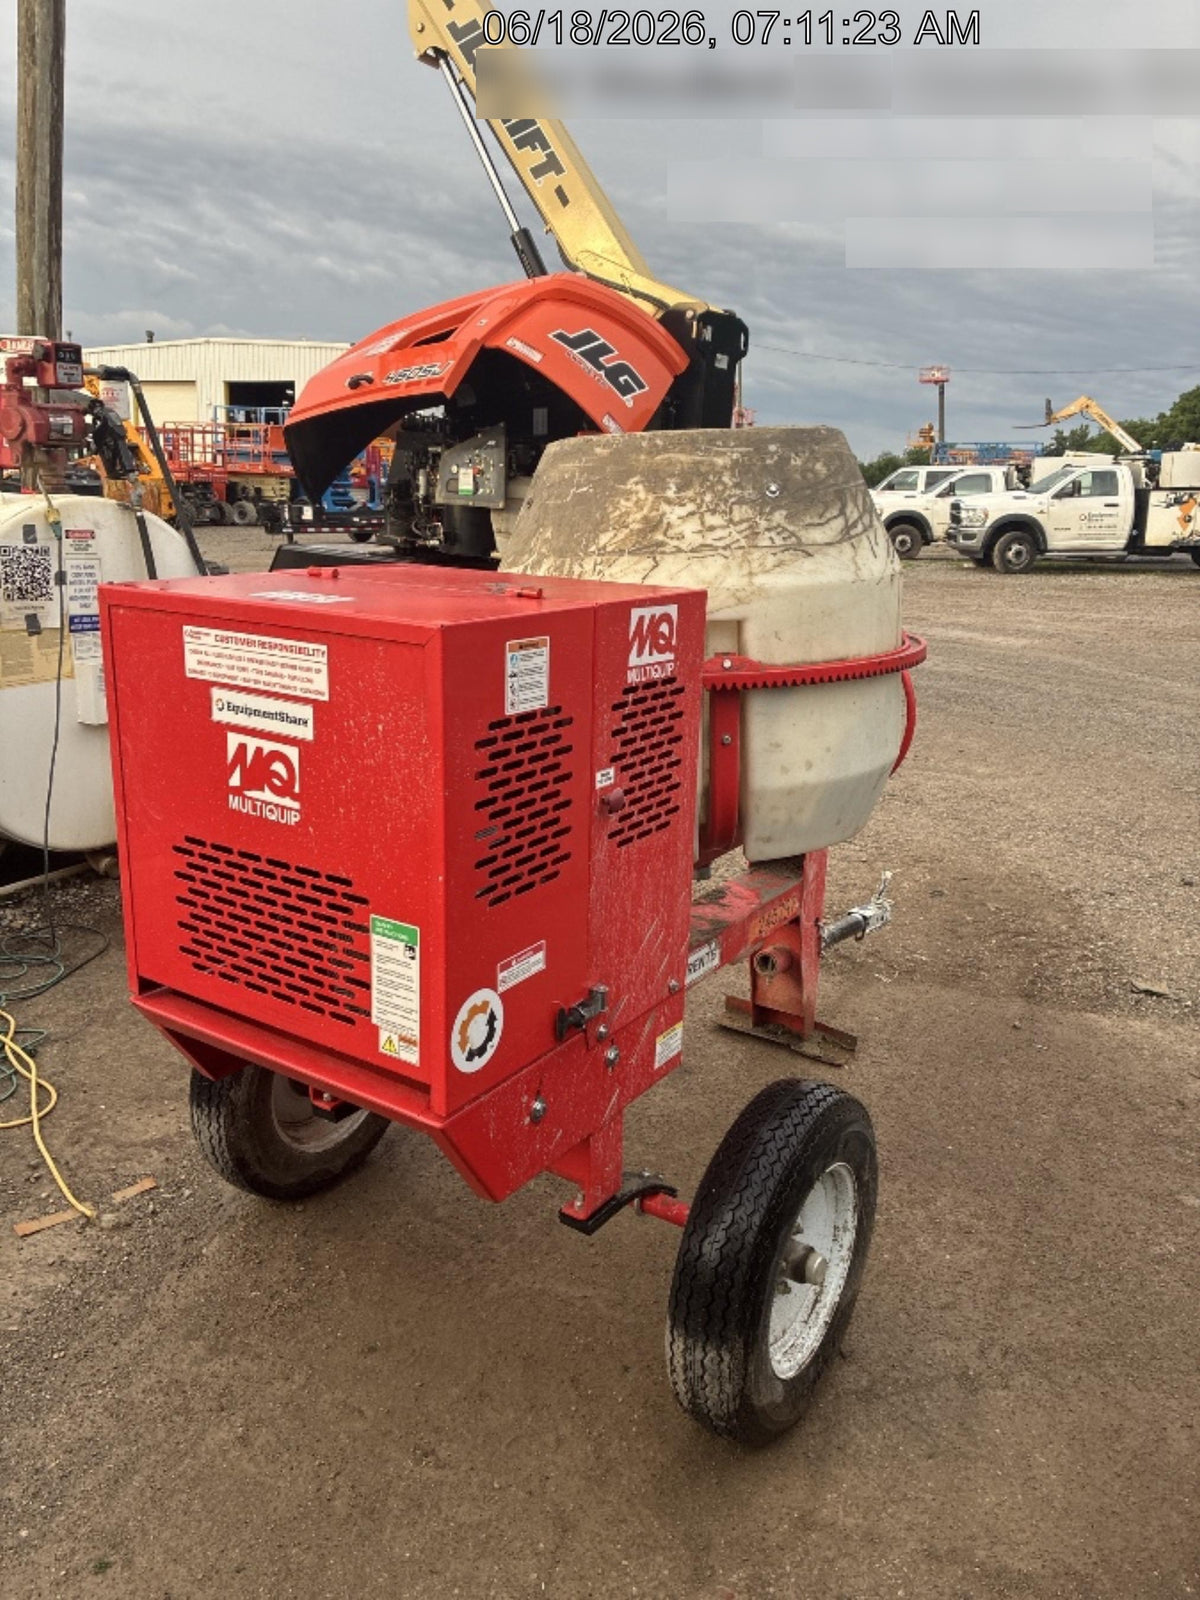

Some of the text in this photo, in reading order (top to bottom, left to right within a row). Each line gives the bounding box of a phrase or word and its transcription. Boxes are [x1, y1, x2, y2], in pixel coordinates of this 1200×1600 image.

[547, 328, 650, 400] JLG
[214, 634, 257, 648] CUSTOMER
[255, 639, 326, 658] RESPONSIBILITY
[627, 662, 674, 684] MULTIQUIP
[226, 701, 309, 727] EquipmentShare
[228, 793, 301, 826] MULTIQUIP
